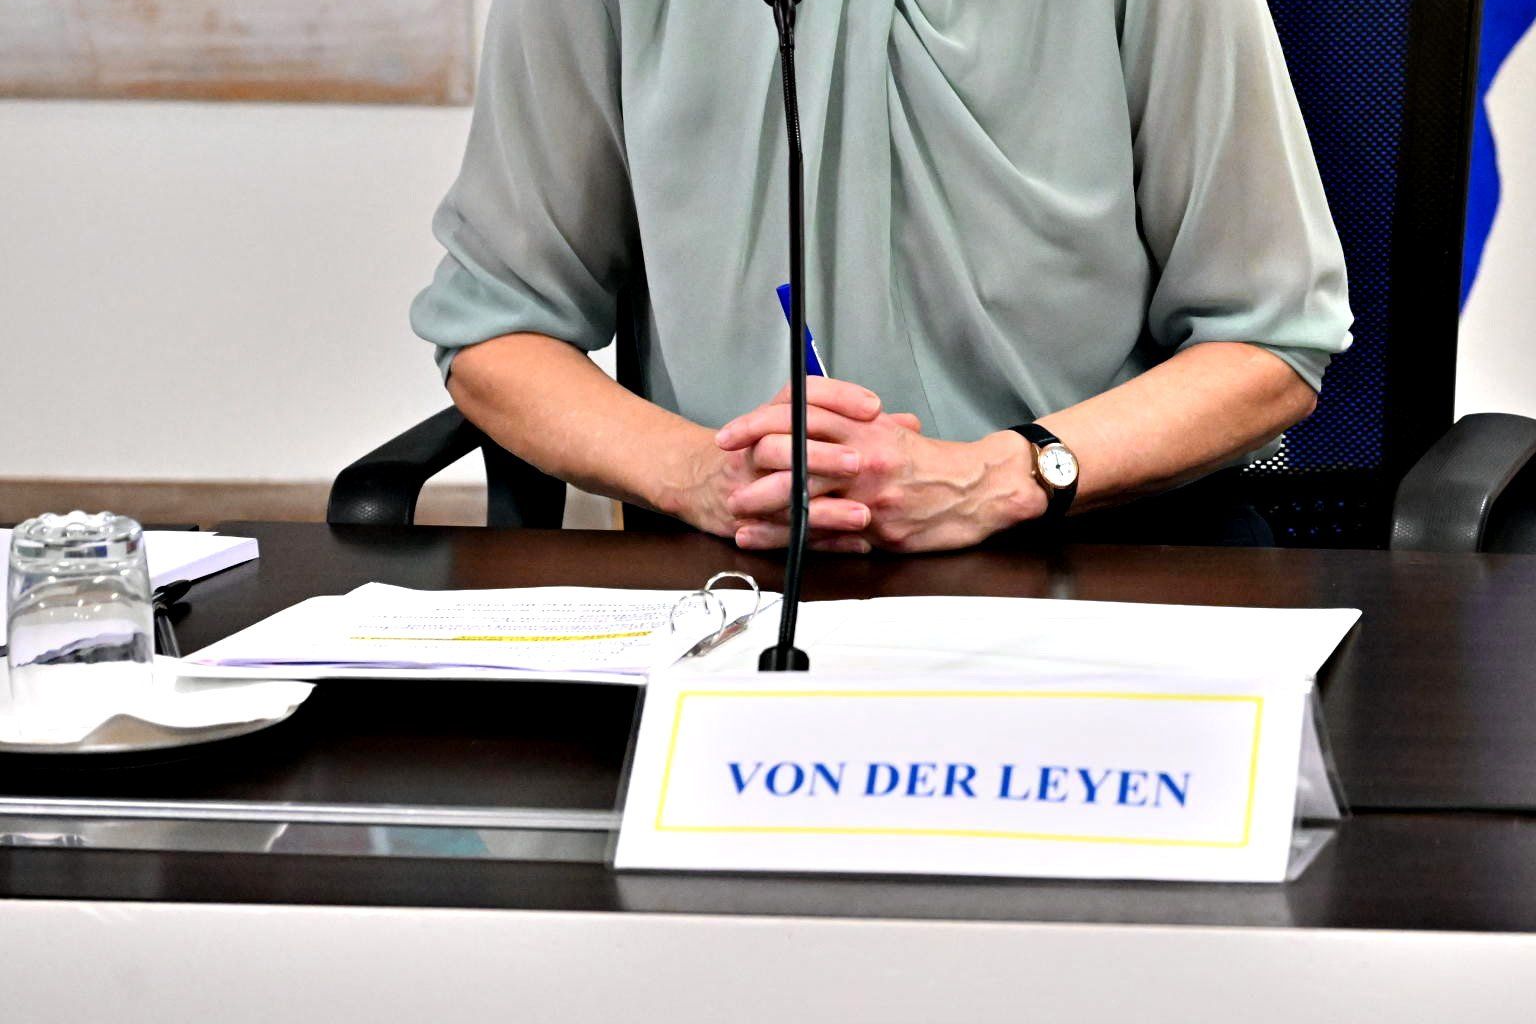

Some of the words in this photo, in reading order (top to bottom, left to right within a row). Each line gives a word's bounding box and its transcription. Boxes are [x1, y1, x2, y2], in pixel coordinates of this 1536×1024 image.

[727, 761, 846, 797] VON
[863, 762, 978, 799] DER
[997, 763, 1191, 807] LEYEN
